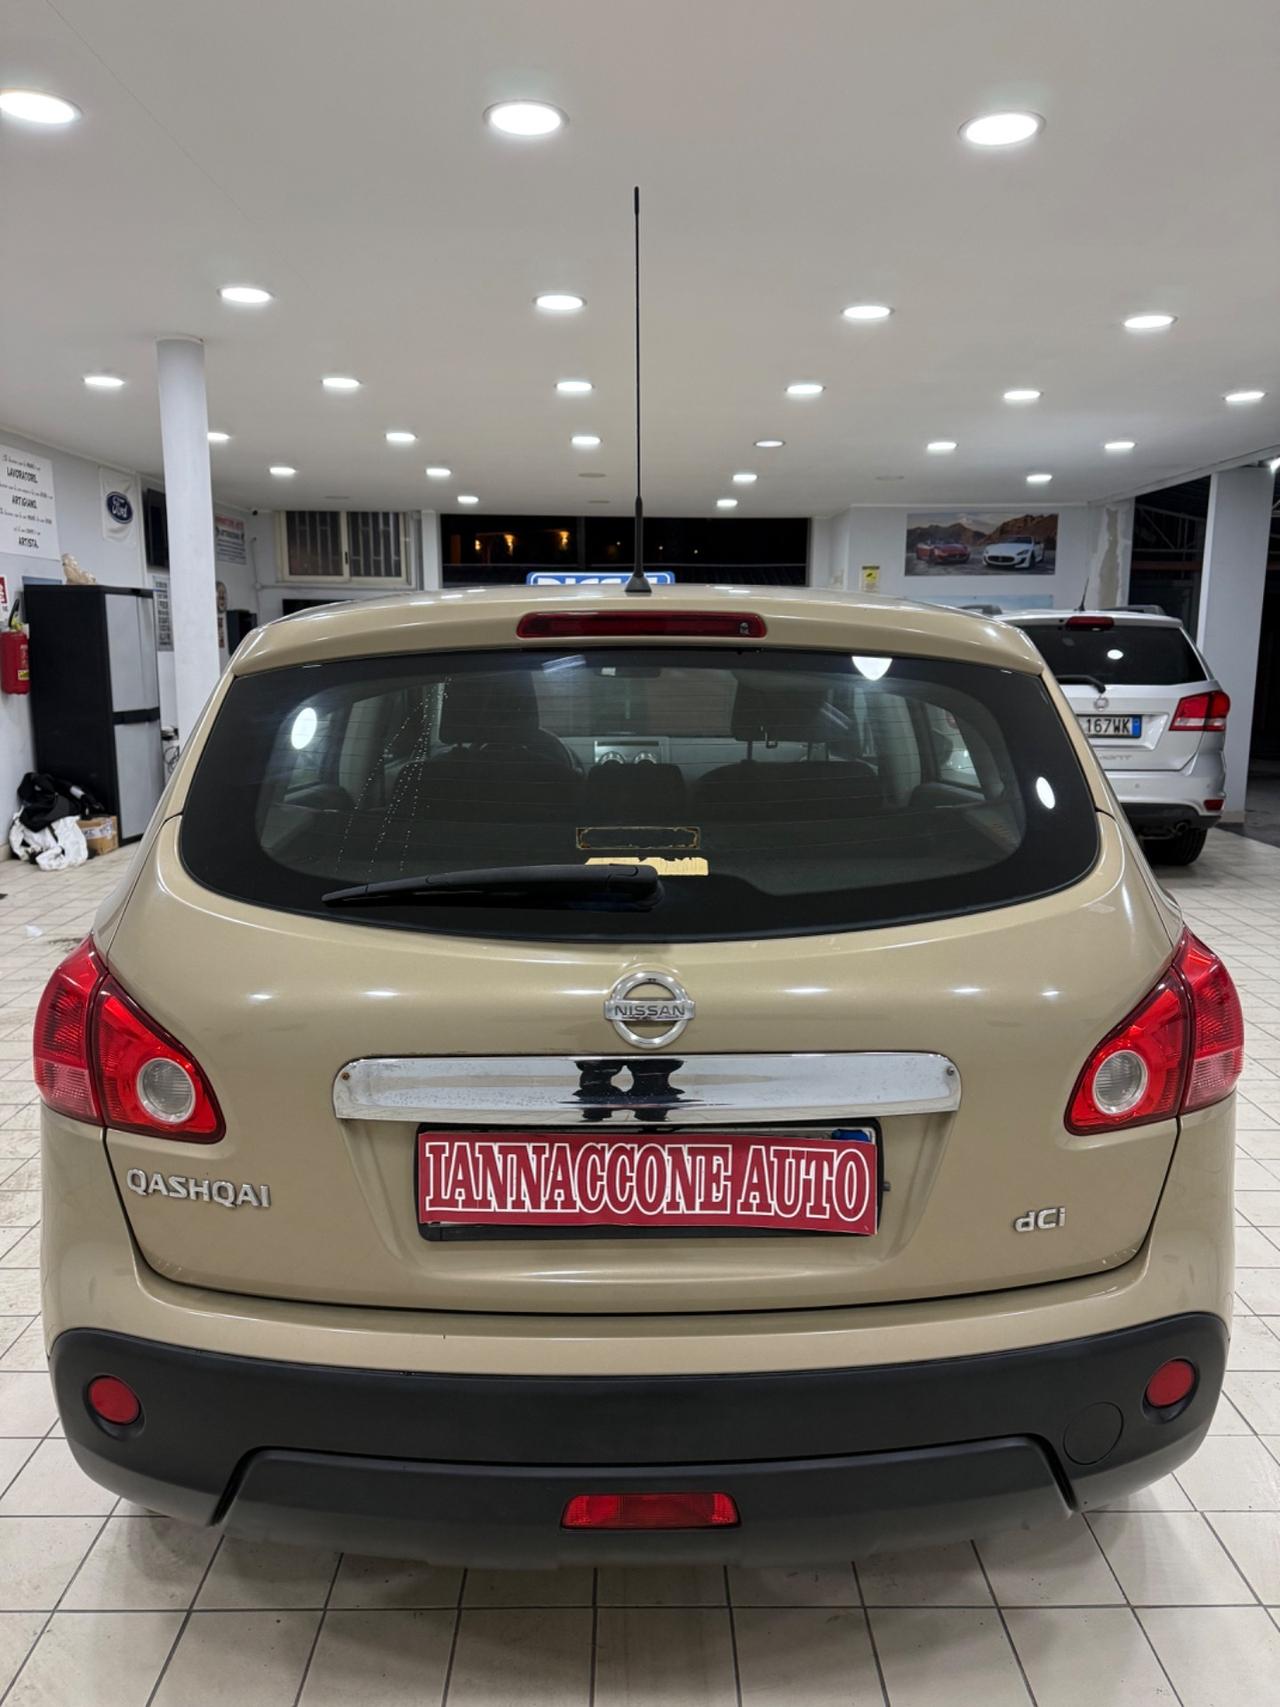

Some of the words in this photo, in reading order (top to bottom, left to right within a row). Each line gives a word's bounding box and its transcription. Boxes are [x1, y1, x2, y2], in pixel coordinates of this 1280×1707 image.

[111, 496, 128, 518] Ford
[1086, 718, 1130, 734] 167WK
[614, 1005, 685, 1016] NISSAN
[126, 1168, 270, 1208] QASHQAI
[425, 1141, 732, 1215] IANNACCONE
[737, 1145, 870, 1222] AUTO
[1014, 1206, 1066, 1232] dCi
